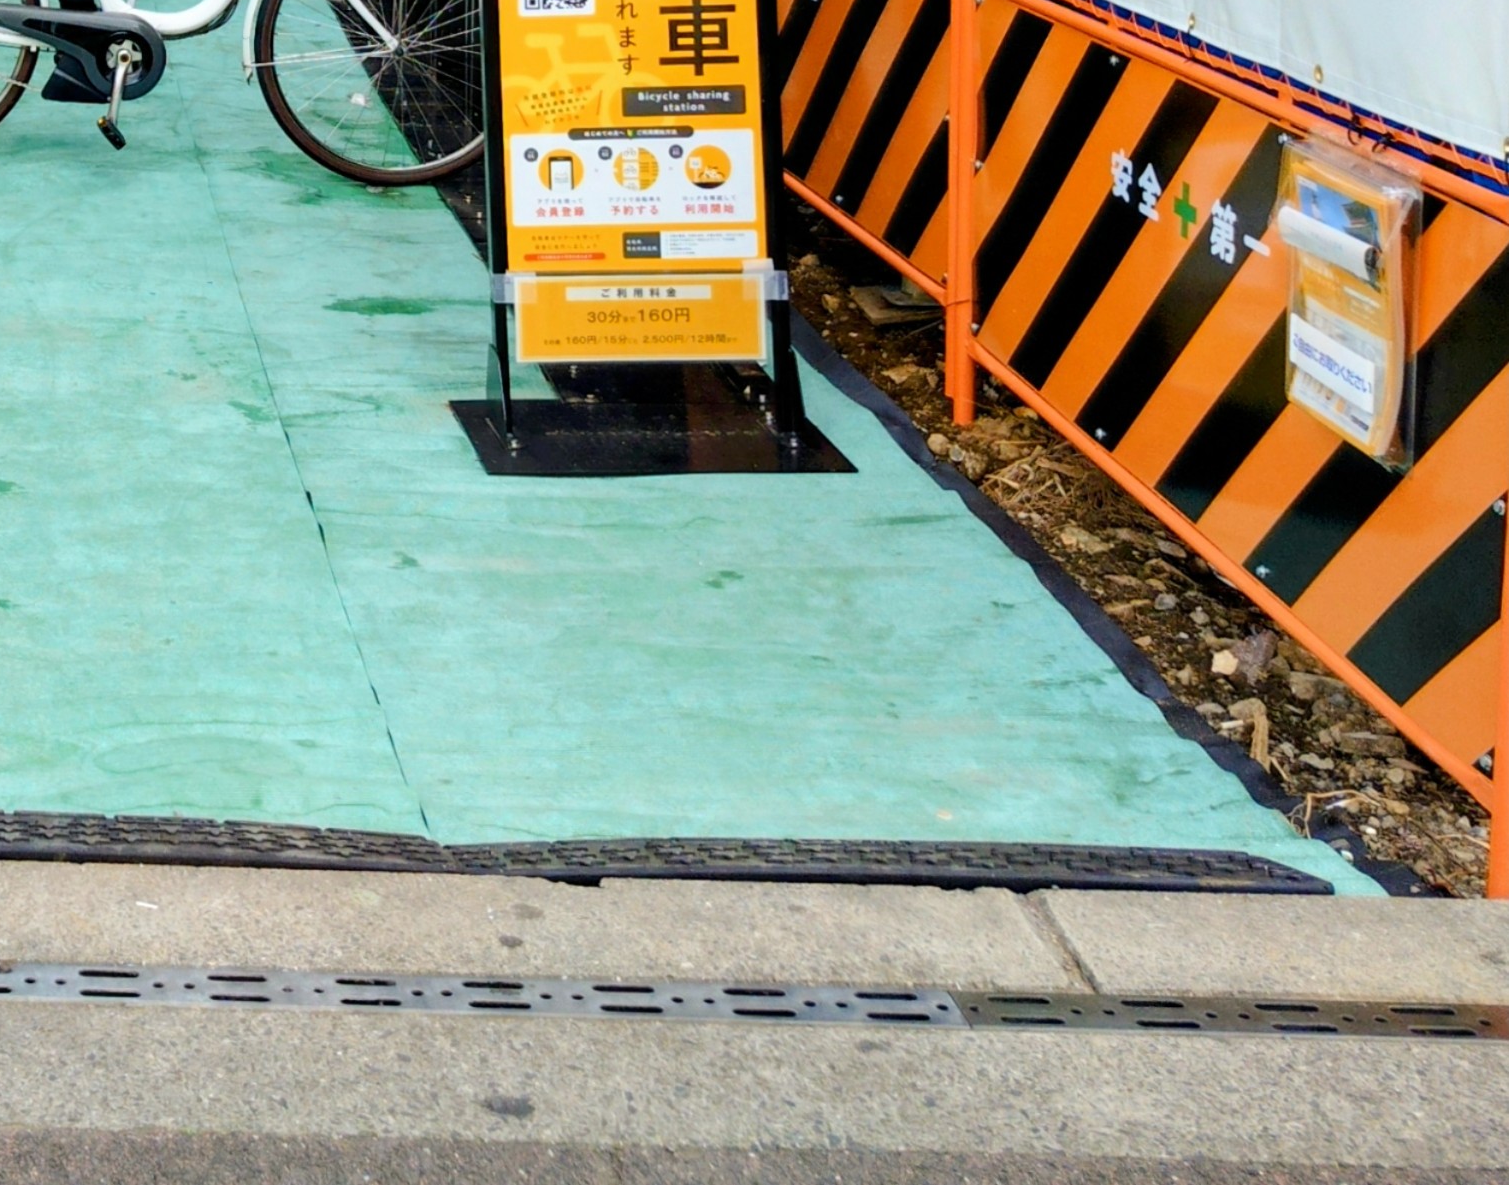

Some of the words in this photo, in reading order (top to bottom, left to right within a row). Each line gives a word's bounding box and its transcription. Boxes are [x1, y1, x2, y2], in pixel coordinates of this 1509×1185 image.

[637, 91, 681, 102] Bicycle
[686, 89, 731, 101] sharing
[662, 102, 706, 112] station
[535, 206, 585, 218] 会員登録
[610, 204, 660, 216] 予約する
[684, 203, 735, 214] 利用開始
[1111, 148, 1161, 221] 安全
[1209, 198, 1270, 265] 第一
[601, 287, 677, 298] ご利用料金
